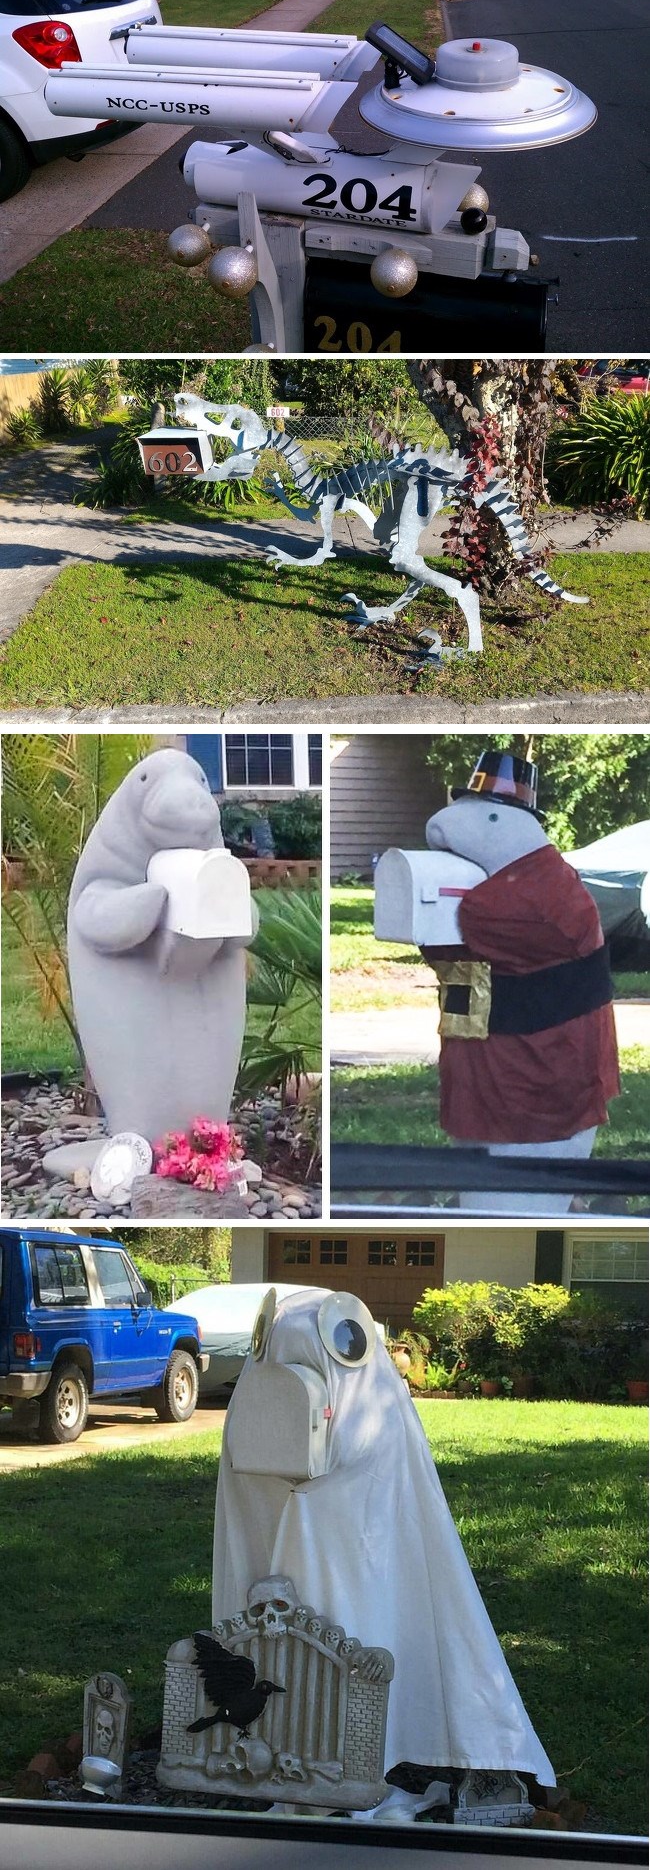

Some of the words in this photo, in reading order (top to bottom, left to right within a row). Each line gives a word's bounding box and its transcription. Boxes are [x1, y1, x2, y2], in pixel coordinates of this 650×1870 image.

[106, 97, 210, 115] NCC-USPS
[302, 173, 417, 222] 204
[310, 209, 407, 228] STARDATE
[313, 315, 402, 353] 204
[271, 407, 285, 417] 602
[148, 451, 198, 472] 602
